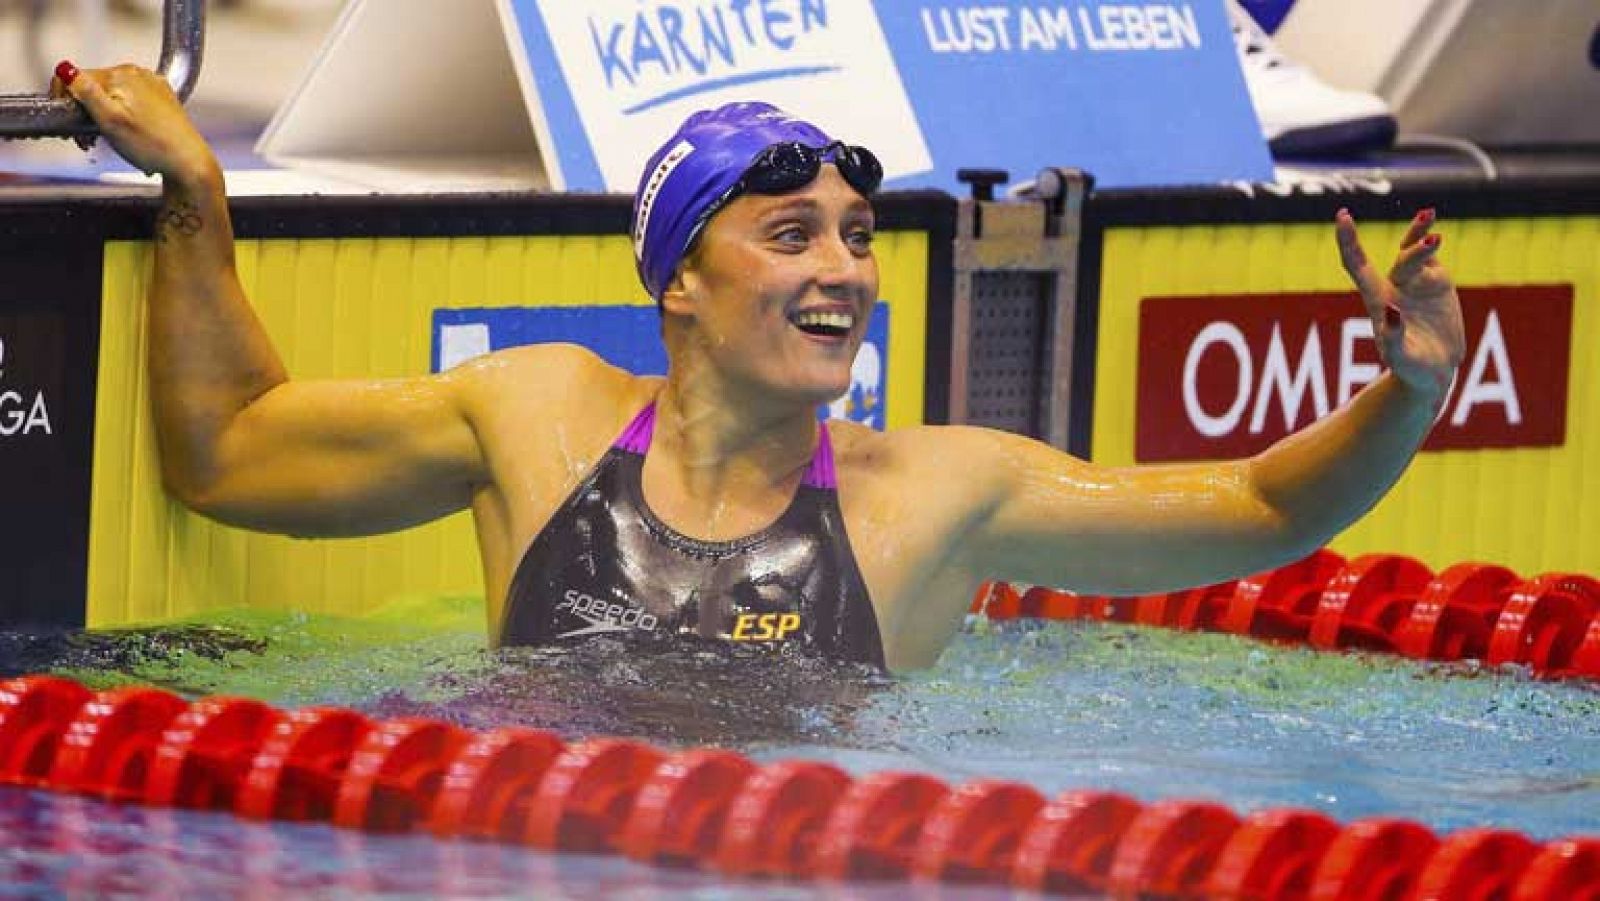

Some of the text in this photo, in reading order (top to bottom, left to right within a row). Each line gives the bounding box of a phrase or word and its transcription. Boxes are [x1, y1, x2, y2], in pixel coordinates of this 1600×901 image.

[921, 4, 1202, 52] LUST AM LEBEN
[1182, 309, 1522, 437] OMEA
[557, 589, 657, 632] speedo
[733, 613, 801, 641] ESP
